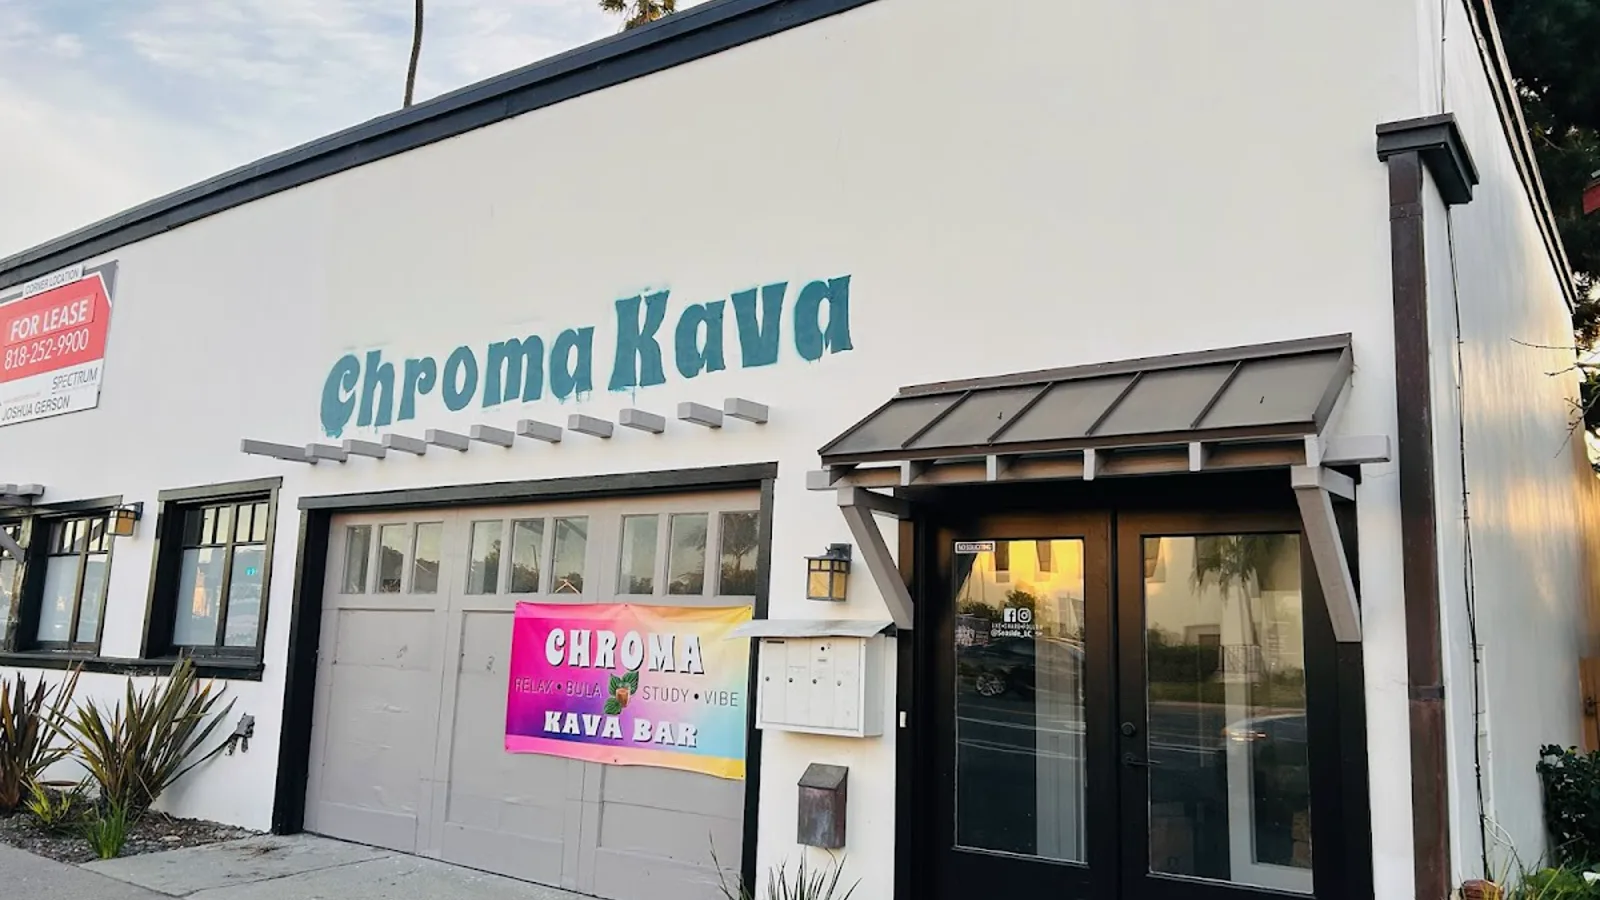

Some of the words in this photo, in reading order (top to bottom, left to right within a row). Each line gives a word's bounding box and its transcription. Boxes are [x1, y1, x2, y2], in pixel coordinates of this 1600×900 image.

[25, 277, 49, 295] CORNER
[49, 268, 80, 289] LOCATION
[10, 315, 39, 341] FOR
[43, 300, 88, 331] LEASE
[4, 328, 89, 370] 818-252-9900
[320, 326, 595, 437] Chroma
[608, 275, 853, 391] Kava
[52, 367, 98, 390] SPECTRUM
[1, 402, 33, 421] JOSHUA
[35, 395, 70, 414] GERSON
[545, 628, 705, 675] CHROMA
[515, 677, 553, 696] RELAX
[565, 679, 603, 699] BULA
[642, 685, 689, 703] STUDY
[704, 690, 739, 707] VIBE
[543, 710, 624, 741] KAVA
[631, 718, 698, 748] BAR
